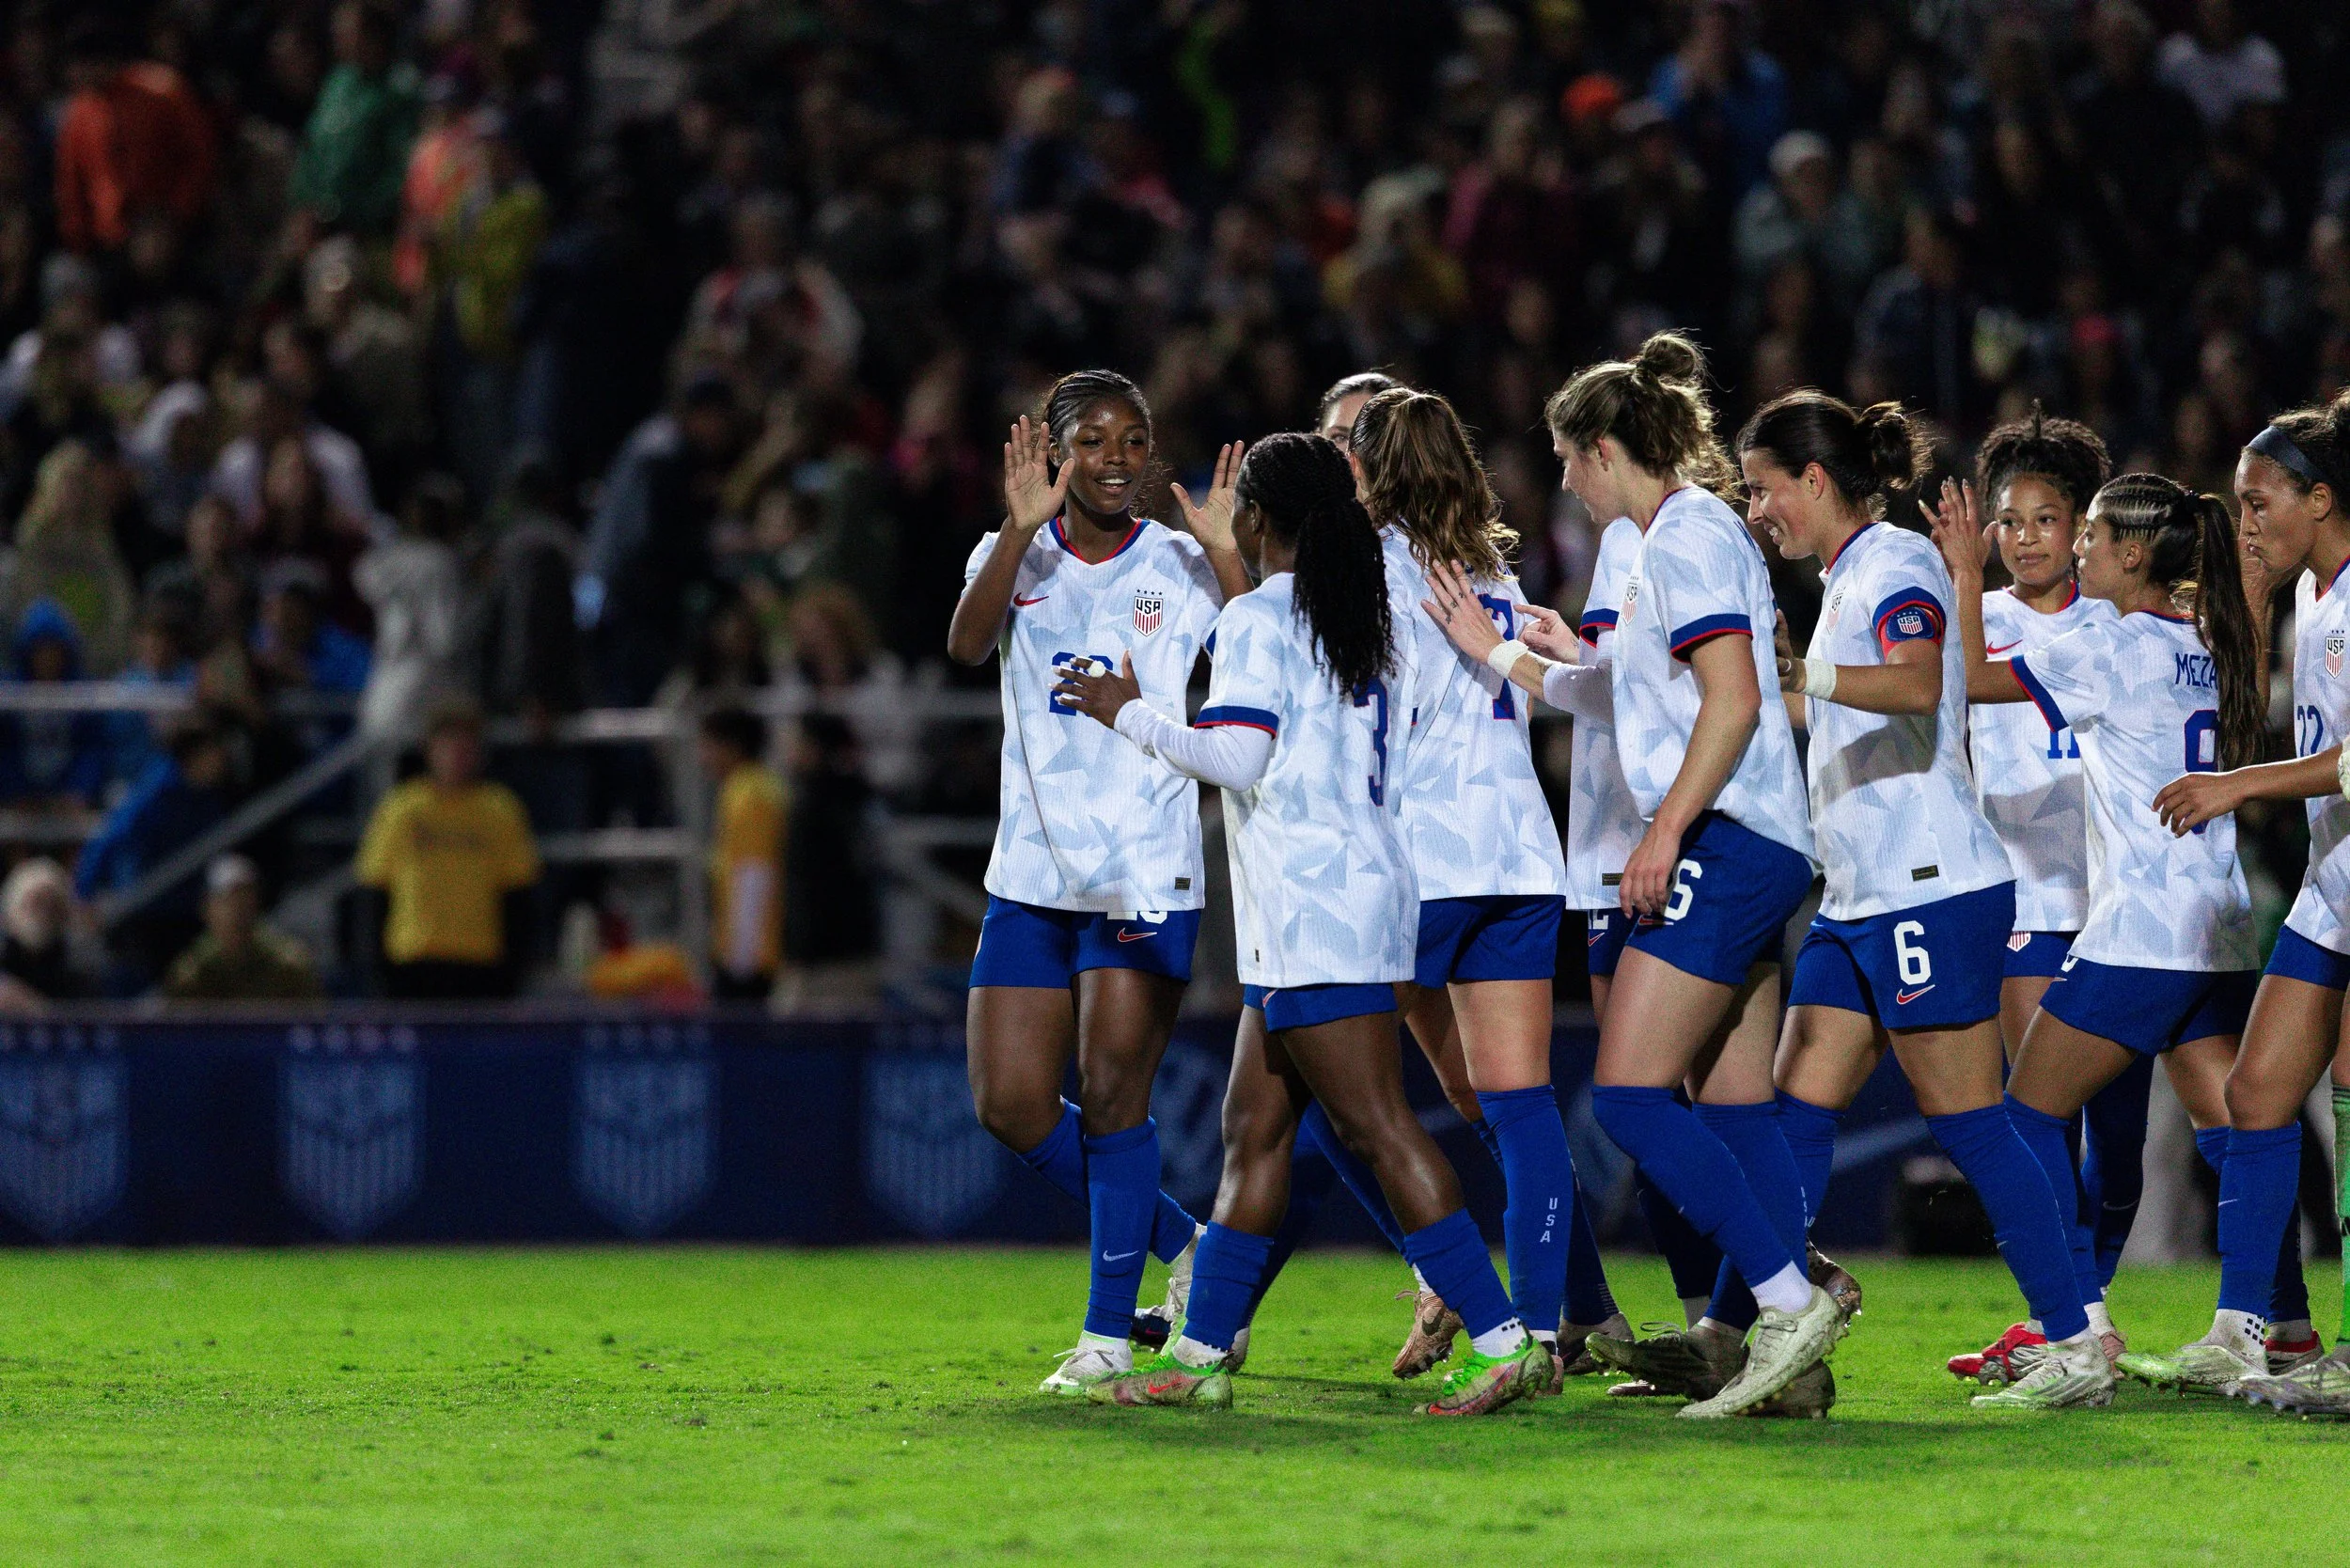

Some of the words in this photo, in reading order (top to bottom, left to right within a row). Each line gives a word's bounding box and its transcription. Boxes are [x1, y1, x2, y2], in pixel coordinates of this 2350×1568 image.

[1136, 599, 1161, 615] USA
[1899, 616, 1919, 625] USA
[2327, 639, 2344, 654] USA
[1049, 651, 1113, 717] 2
[2175, 652, 2218, 690] MEZA
[1353, 676, 1388, 807] 3
[1893, 920, 1932, 985] 6
[1540, 1197, 1559, 1243] USA
